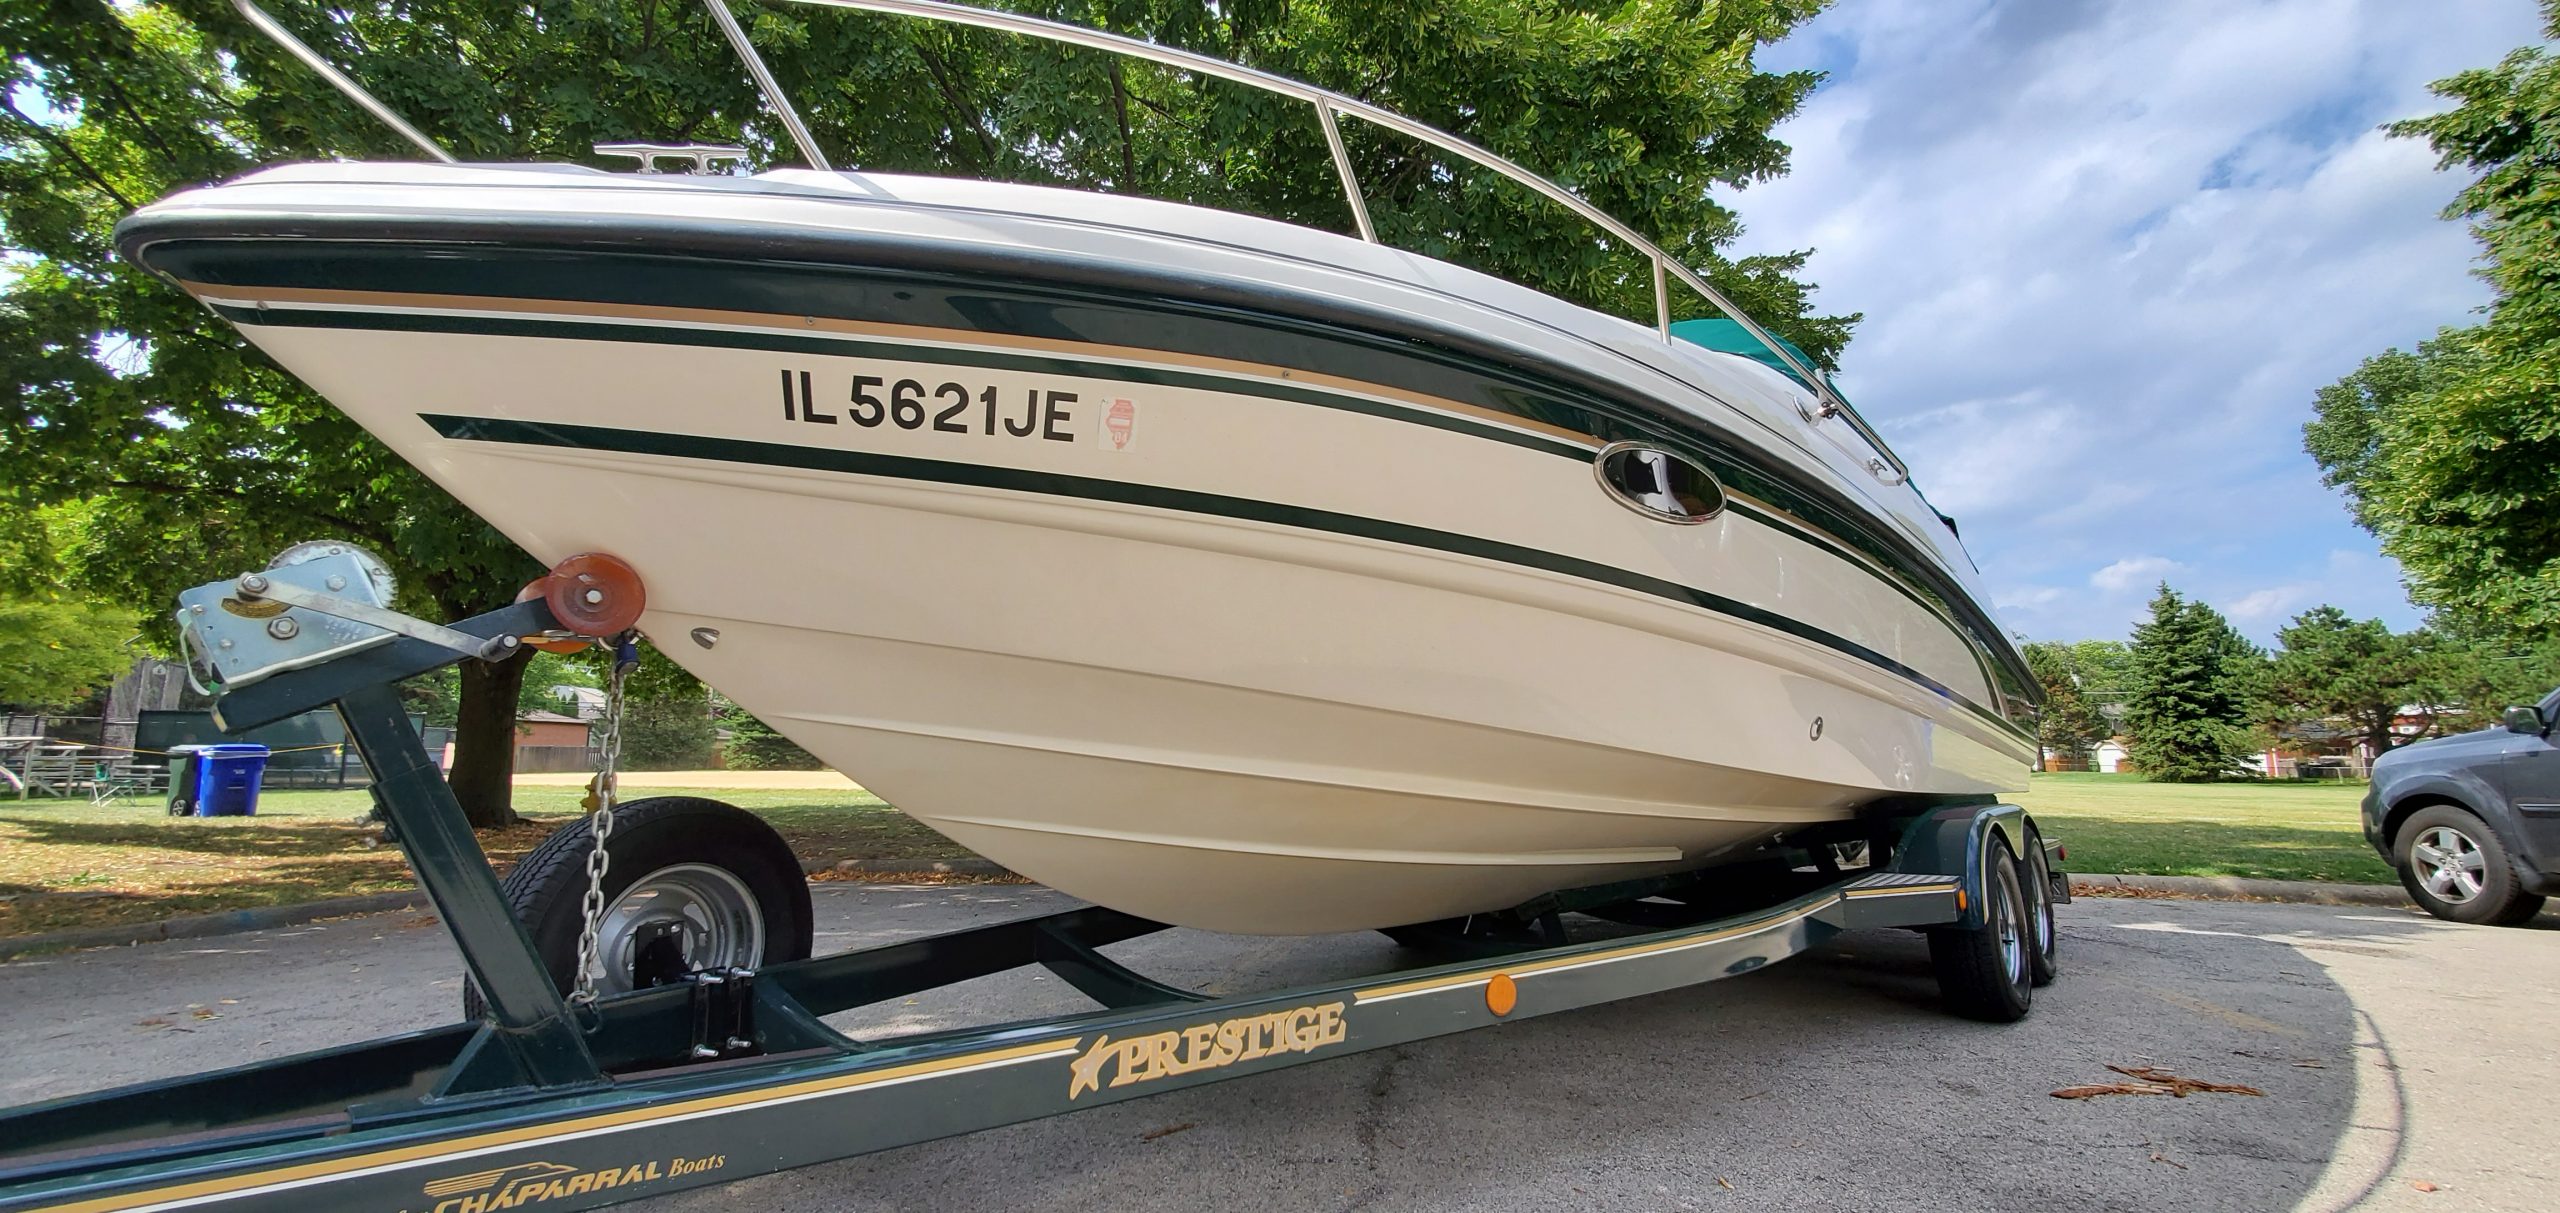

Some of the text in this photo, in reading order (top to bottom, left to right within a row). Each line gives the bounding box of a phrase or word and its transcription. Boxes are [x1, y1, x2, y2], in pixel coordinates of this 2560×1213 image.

[1108, 1001, 1347, 1088] PRESTIGE
[433, 1153, 726, 1213] CHAPARRAL Boats
